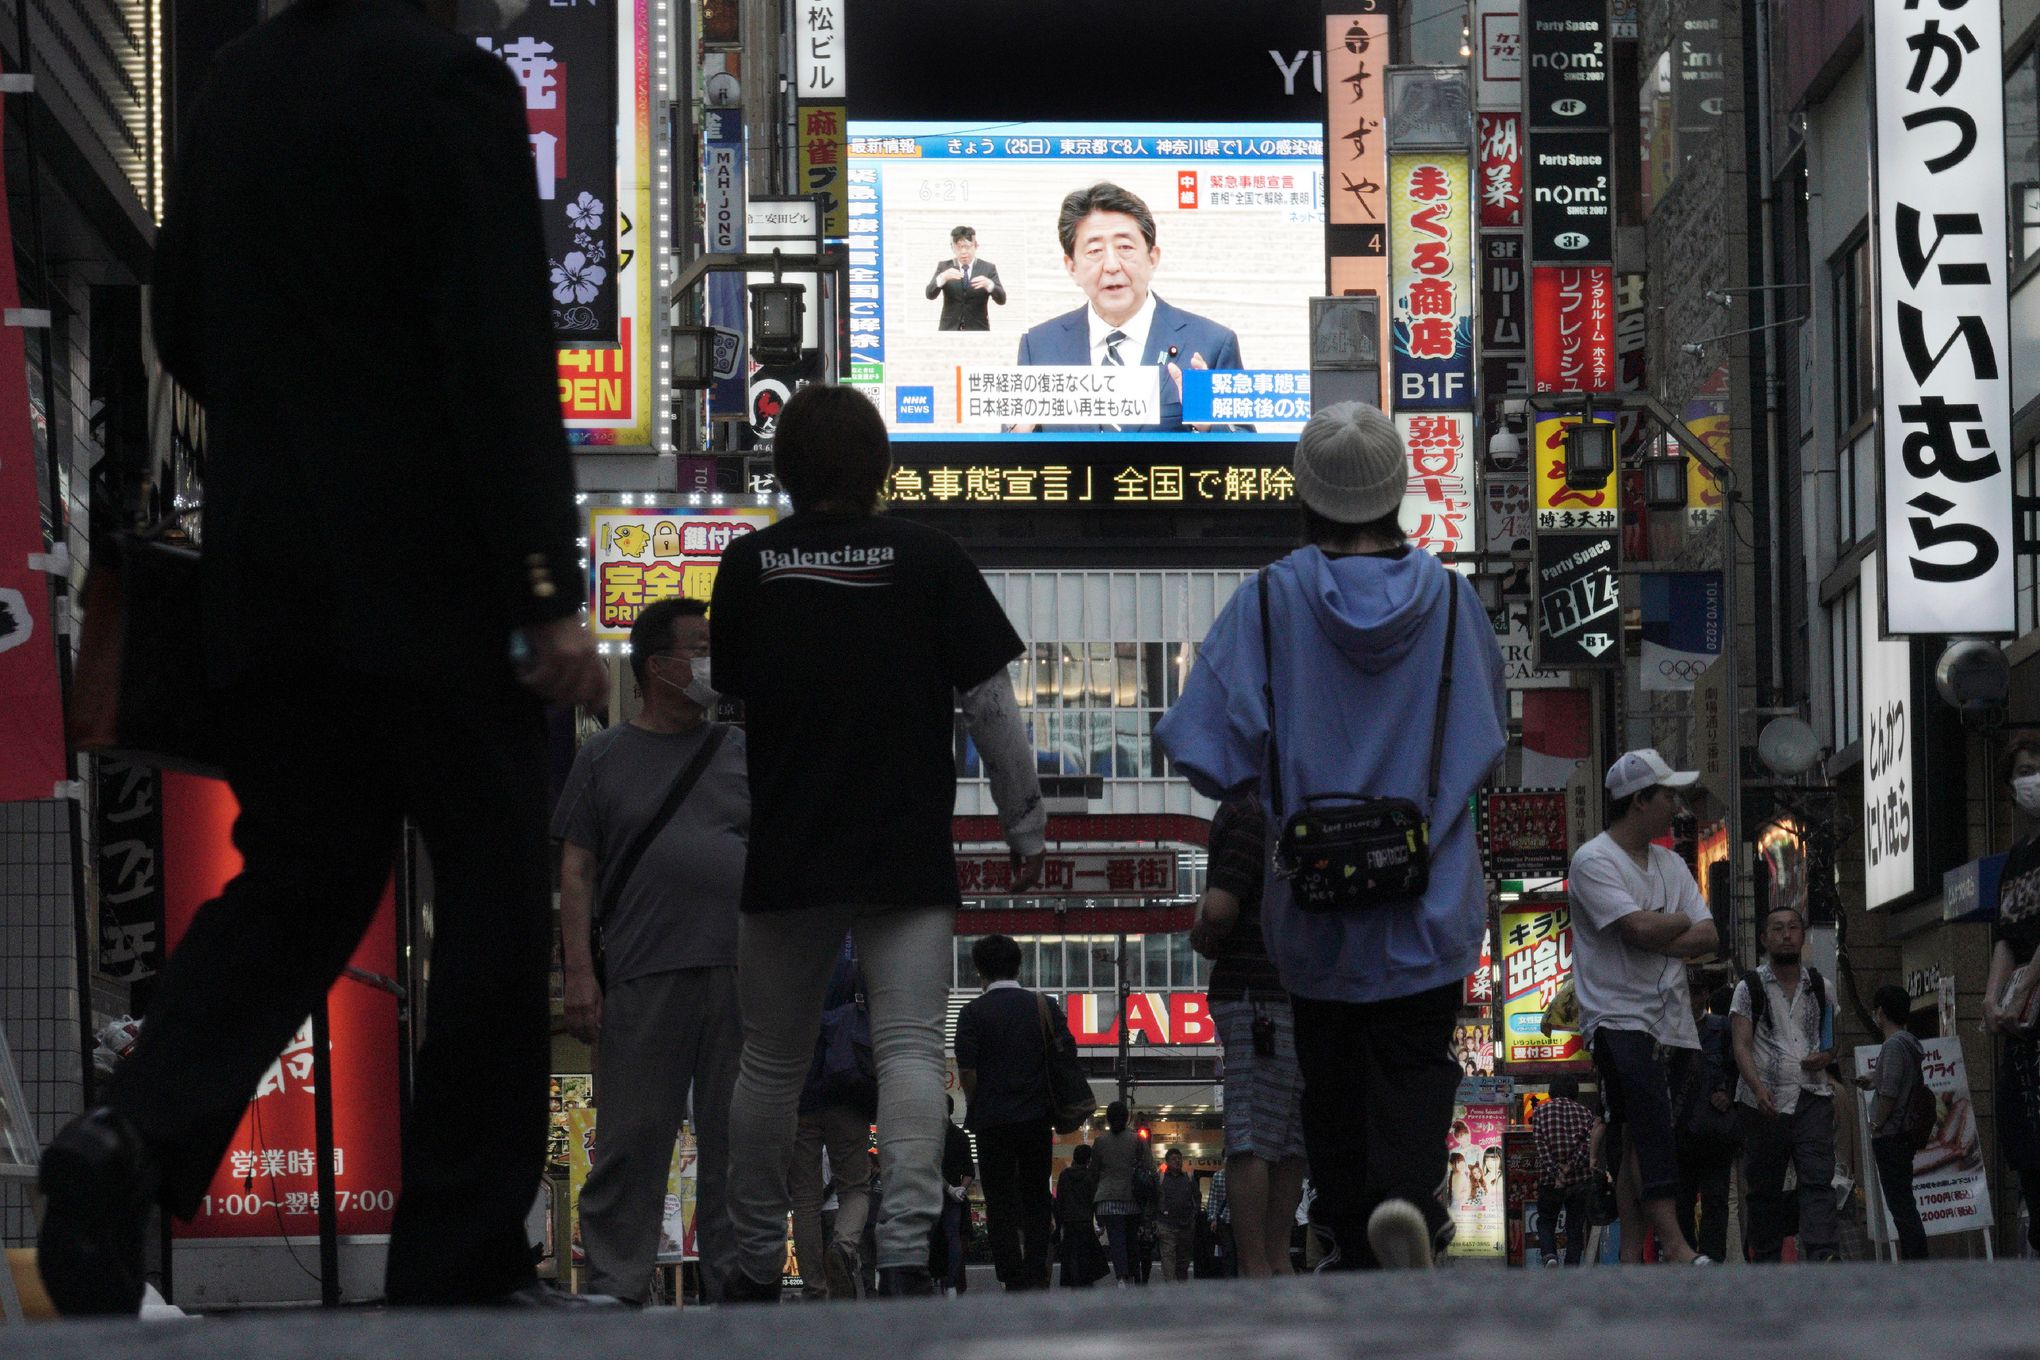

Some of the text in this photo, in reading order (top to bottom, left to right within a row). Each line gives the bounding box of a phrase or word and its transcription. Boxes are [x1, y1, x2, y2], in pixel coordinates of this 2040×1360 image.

[1536, 20, 1599, 32] Party Space
[807, 0, 835, 90] 松ビル
[1269, 50, 1323, 95] Y
[1559, 102, 1577, 112] 4F
[850, 138, 916, 154] 最新情報
[1341, 62, 1381, 220] すずや
[1539, 154, 1602, 166] Party Space
[1180, 175, 1196, 205] 中継
[1209, 175, 1295, 189] 緊急事態宣言
[1566, 206, 1608, 216] SINCE 2007
[1368, 233, 1382, 253] 4
[1563, 236, 1581, 248] 3F
[1409, 165, 1456, 357] まぐろ商店
[1895, 0, 2002, 584] かつにいむら
[1492, 266, 1522, 344] ルーム
[1559, 269, 1584, 394] リフレッシュ
[1590, 268, 1607, 388] レンタルルーム ホステル
[968, 373, 1116, 393] 世界経済の復活なくして
[1401, 373, 1465, 400] B1F
[900, 404, 930, 414] NEWS
[902, 396, 928, 404] NHK
[968, 397, 1148, 418] 日本経済の力強い再生もない
[1538, 511, 1616, 529] 博多天神
[759, 544, 895, 569] Balenciaga
[1541, 539, 1612, 582] Party Space
[1704, 581, 1718, 650] TOKYO 2020
[1585, 636, 1608, 647] B1
[1869, 698, 1906, 782] とんかつ
[1866, 776, 1911, 870] にいむら
[1509, 908, 1571, 946] キラリ
[1513, 1045, 1565, 1059] 受付3F
